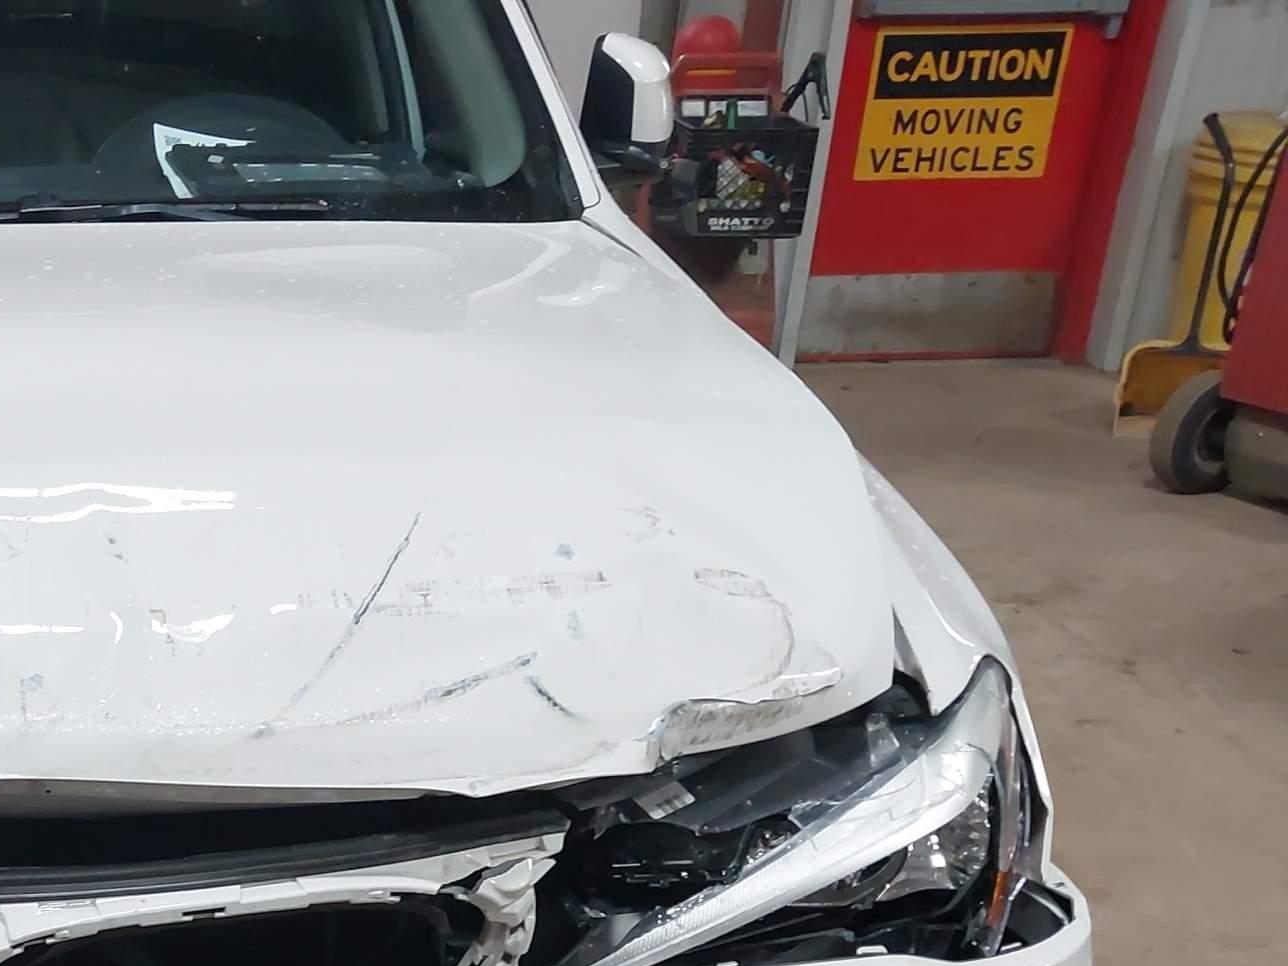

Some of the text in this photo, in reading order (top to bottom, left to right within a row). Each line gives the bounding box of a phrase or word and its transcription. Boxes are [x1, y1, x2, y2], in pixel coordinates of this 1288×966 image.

[887, 49, 1054, 82] CAUTION
[892, 108, 1023, 135] MOVING
[870, 145, 1035, 173] VEHICLES
